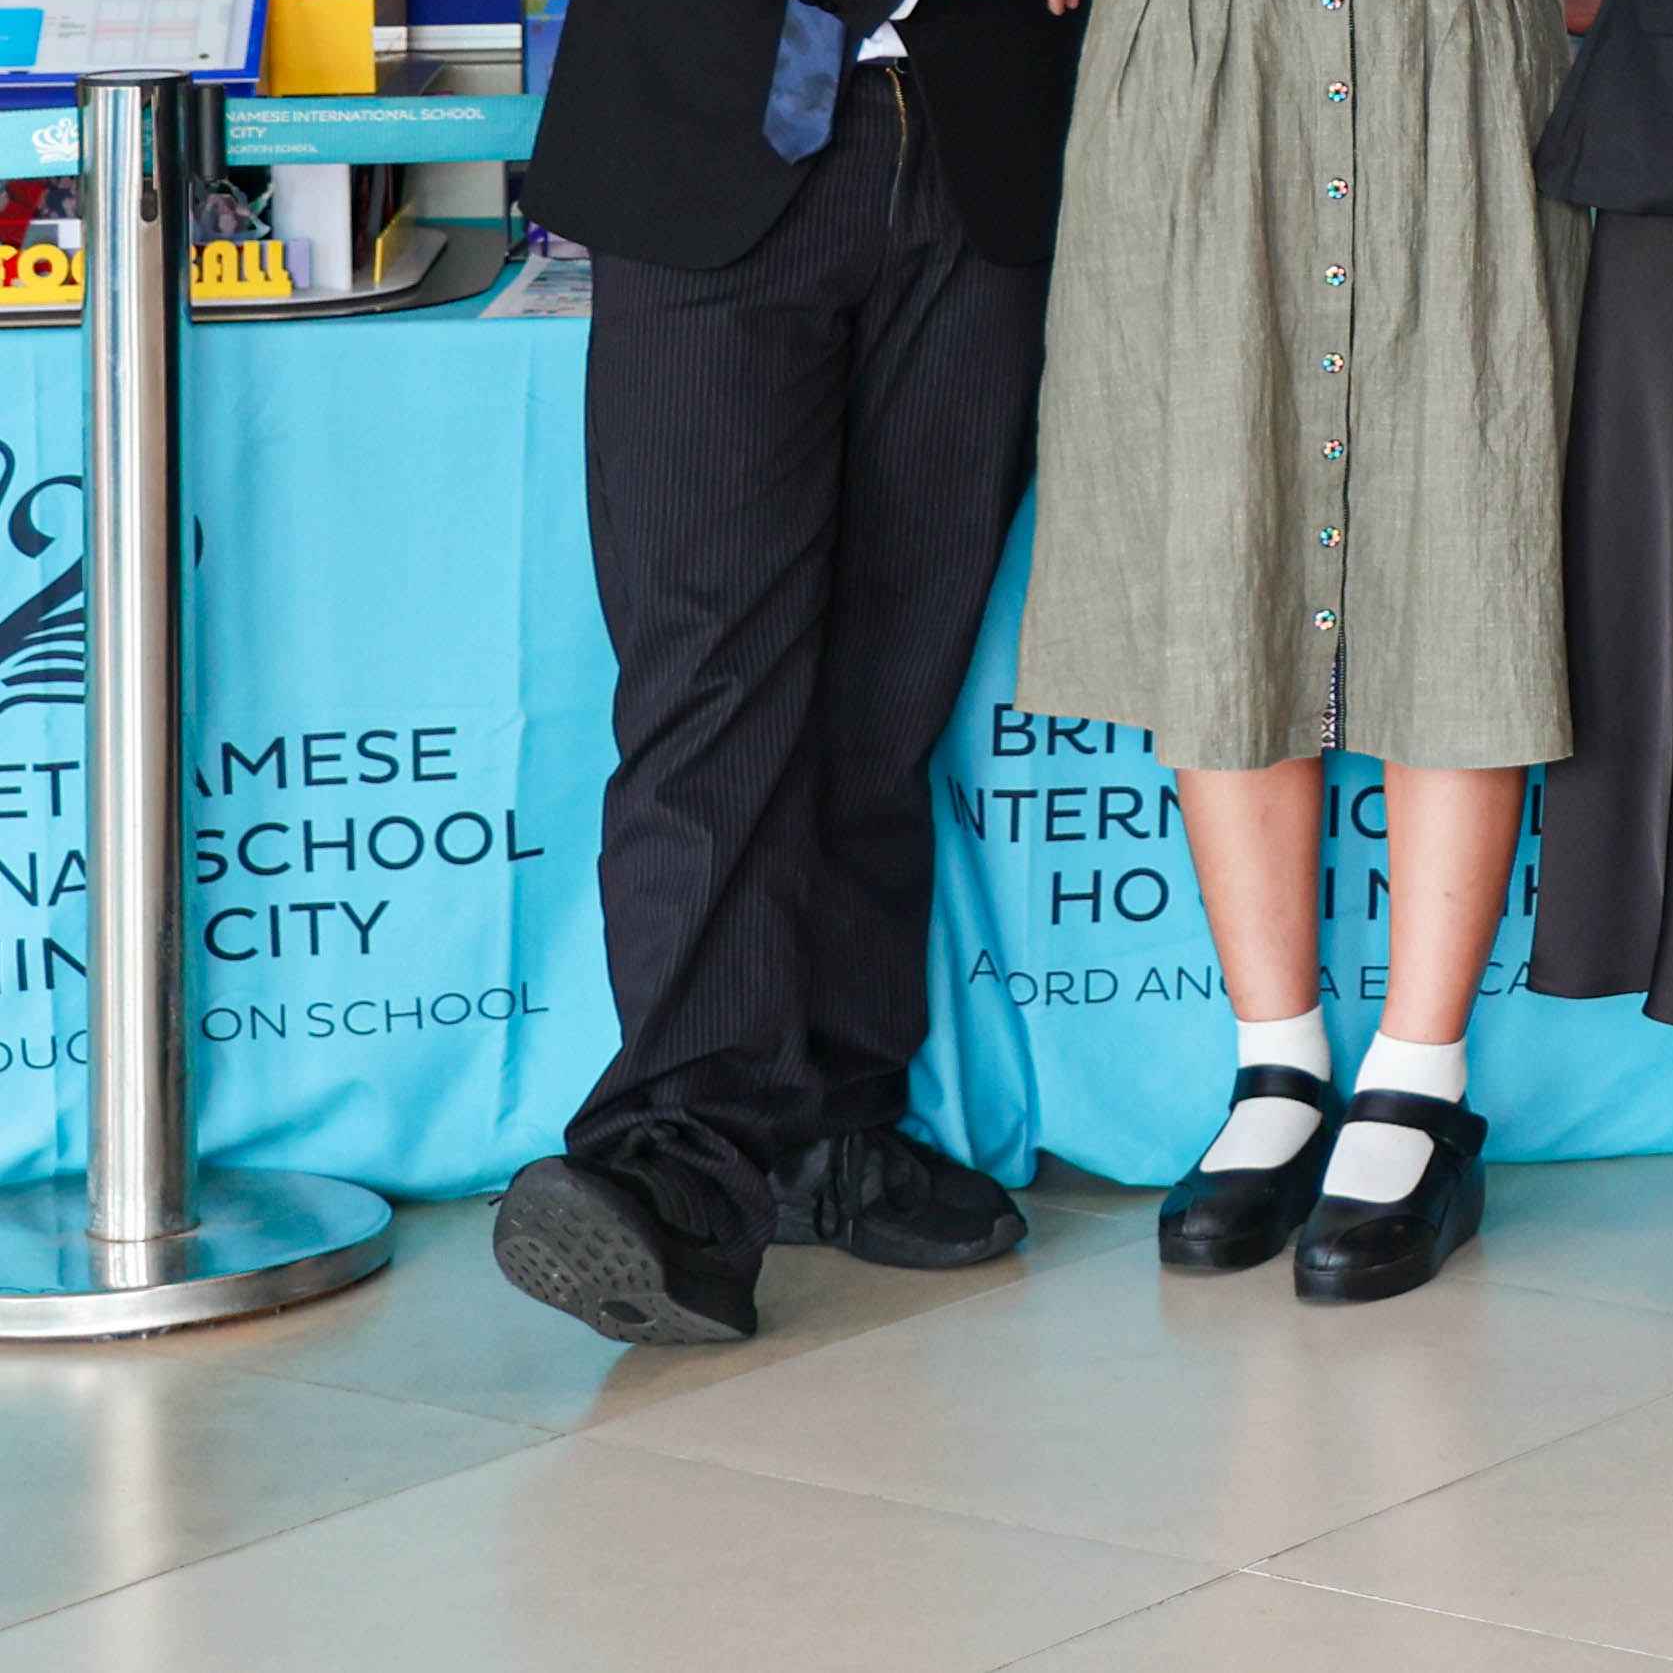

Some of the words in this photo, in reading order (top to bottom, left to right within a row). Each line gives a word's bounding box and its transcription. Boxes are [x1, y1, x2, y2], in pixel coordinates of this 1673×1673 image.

[226, 110, 290, 123] NAMESE
[293, 108, 417, 123] INTERNATIONAL
[420, 107, 485, 121] SCHOOL
[231, 126, 268, 139] CITY
[195, 809, 546, 884] SCHOOL
[1051, 866, 1169, 925] HO
[204, 900, 390, 962] CITY
[305, 981, 550, 1038] SCHOOL
[1009, 967, 1119, 1009] ORD
